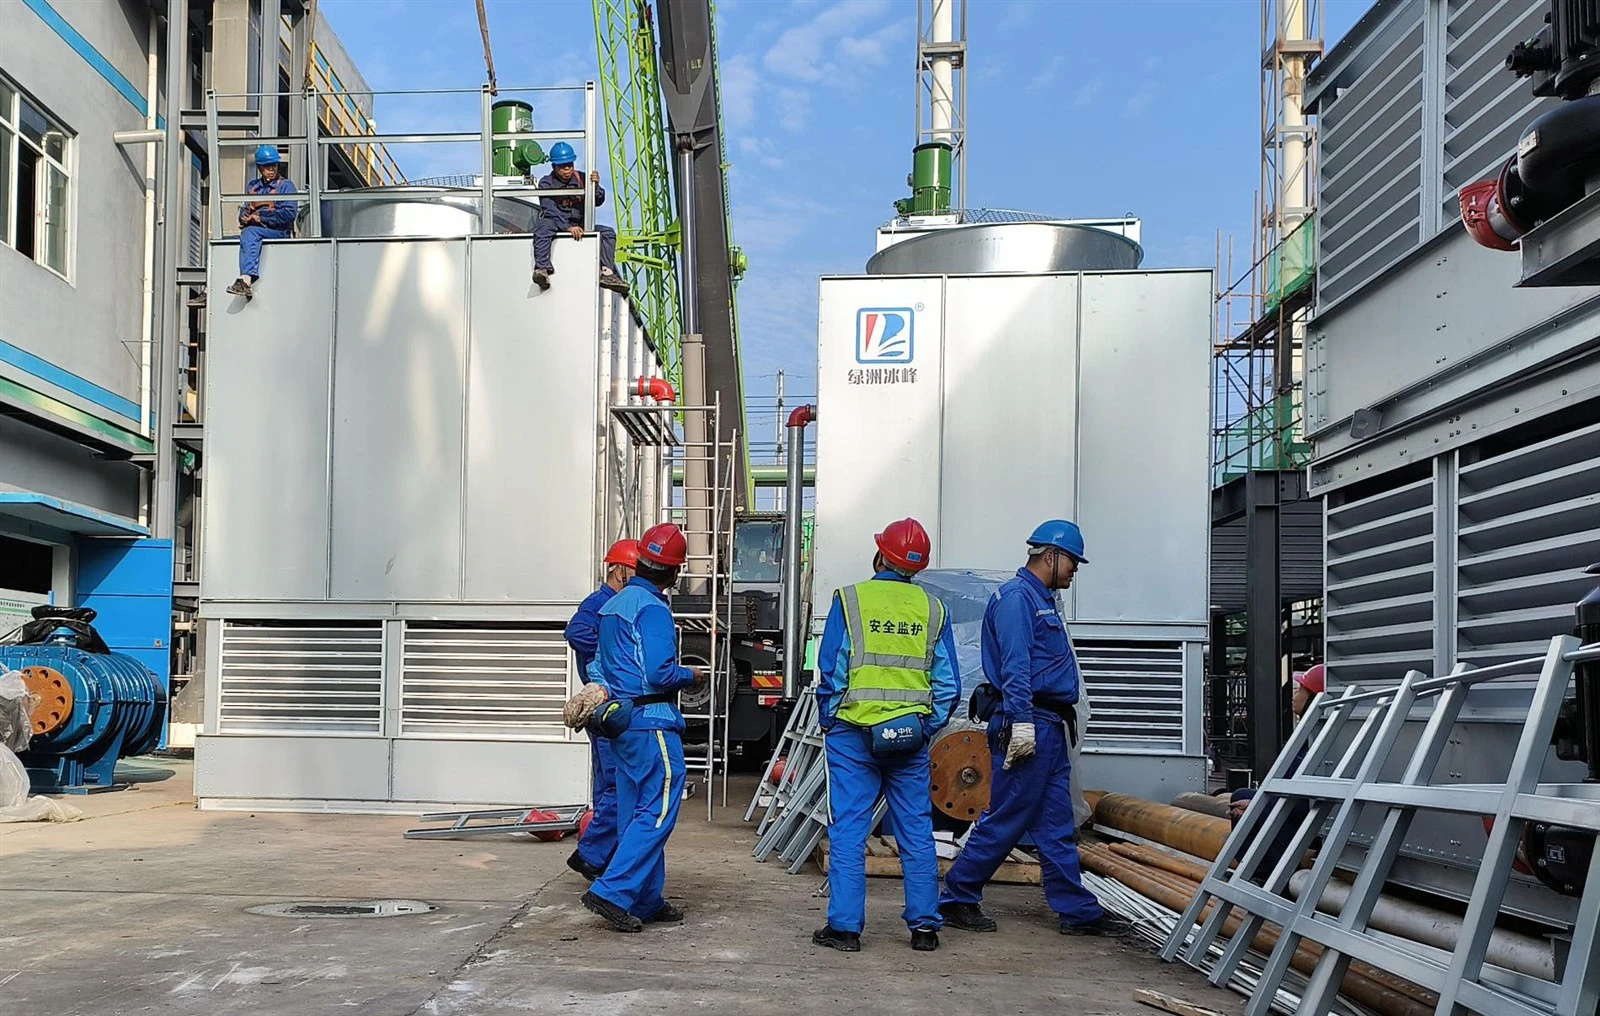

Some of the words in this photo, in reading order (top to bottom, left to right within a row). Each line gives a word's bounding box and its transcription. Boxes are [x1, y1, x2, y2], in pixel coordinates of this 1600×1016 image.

[847, 367, 918, 385] 绿洲冰峰
[869, 618, 923, 636] 安全监护
